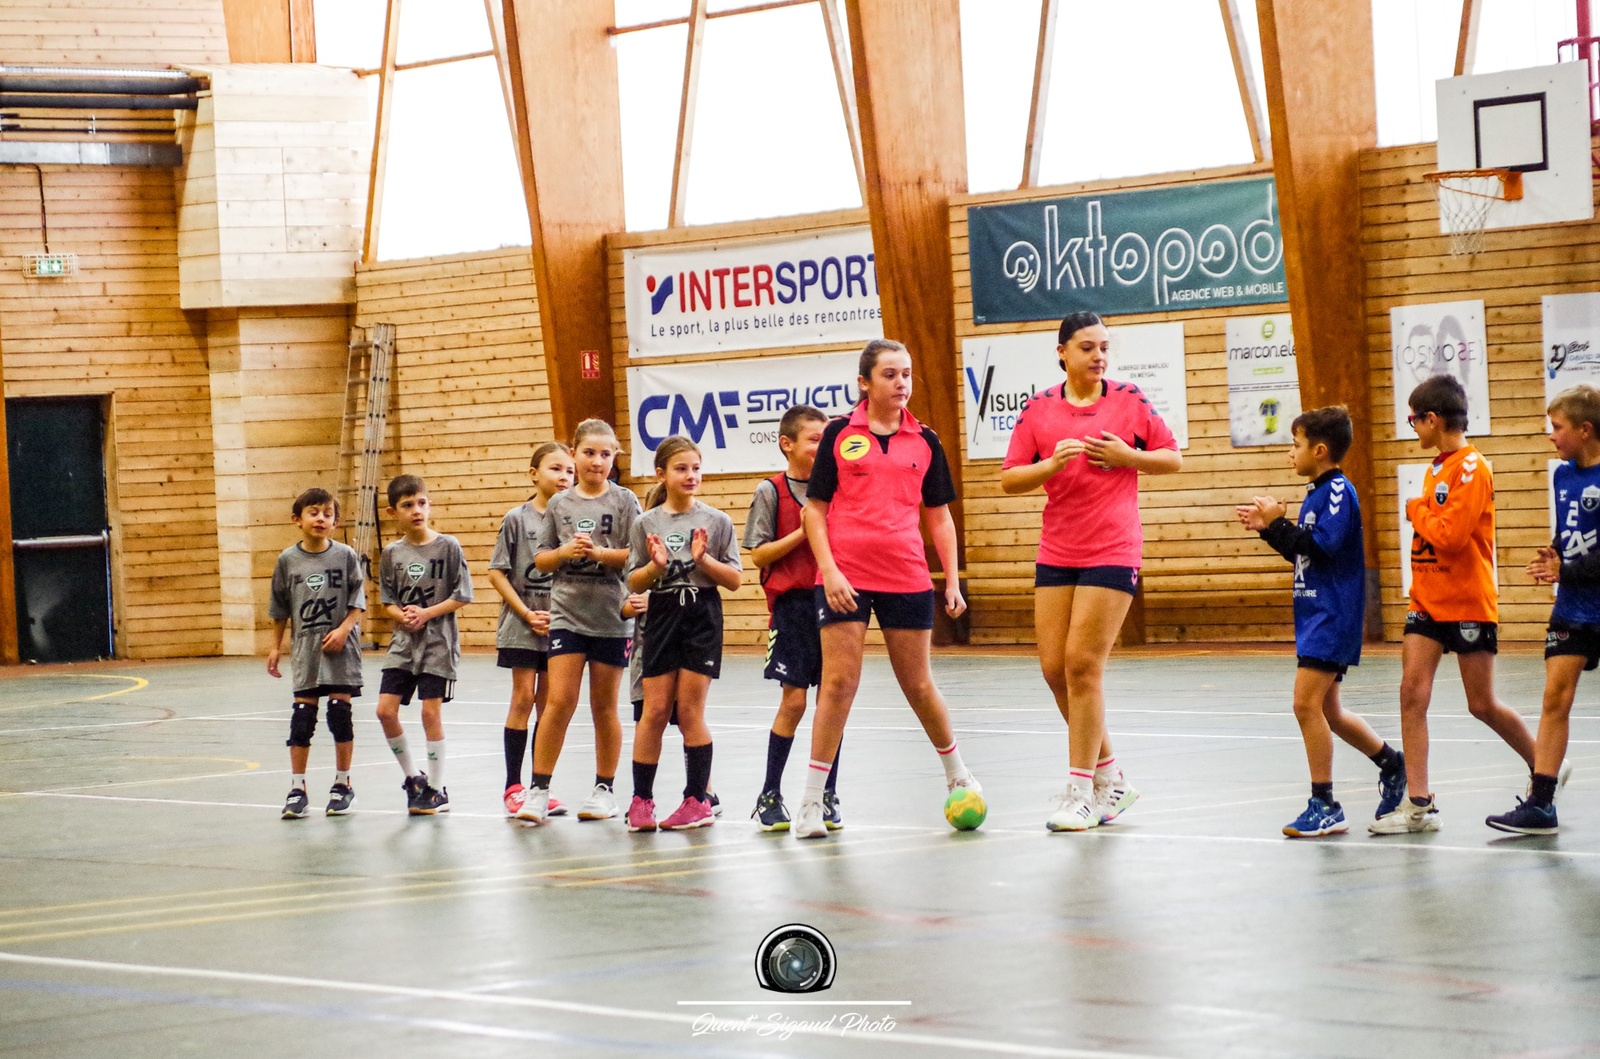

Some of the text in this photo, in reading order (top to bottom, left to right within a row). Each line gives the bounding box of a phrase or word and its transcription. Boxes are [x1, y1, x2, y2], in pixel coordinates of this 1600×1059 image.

[1172, 282, 1285, 301] AGENCE WEB & MOBILE
[651, 307, 882, 338] Le sport, la plus belle des rencontres
[637, 391, 741, 451] CMF
[991, 415, 1018, 430] TEC
[1566, 501, 1579, 526] 2
[601, 514, 613, 534] 9
[325, 569, 343, 588] 12
[430, 559, 444, 579] 11
